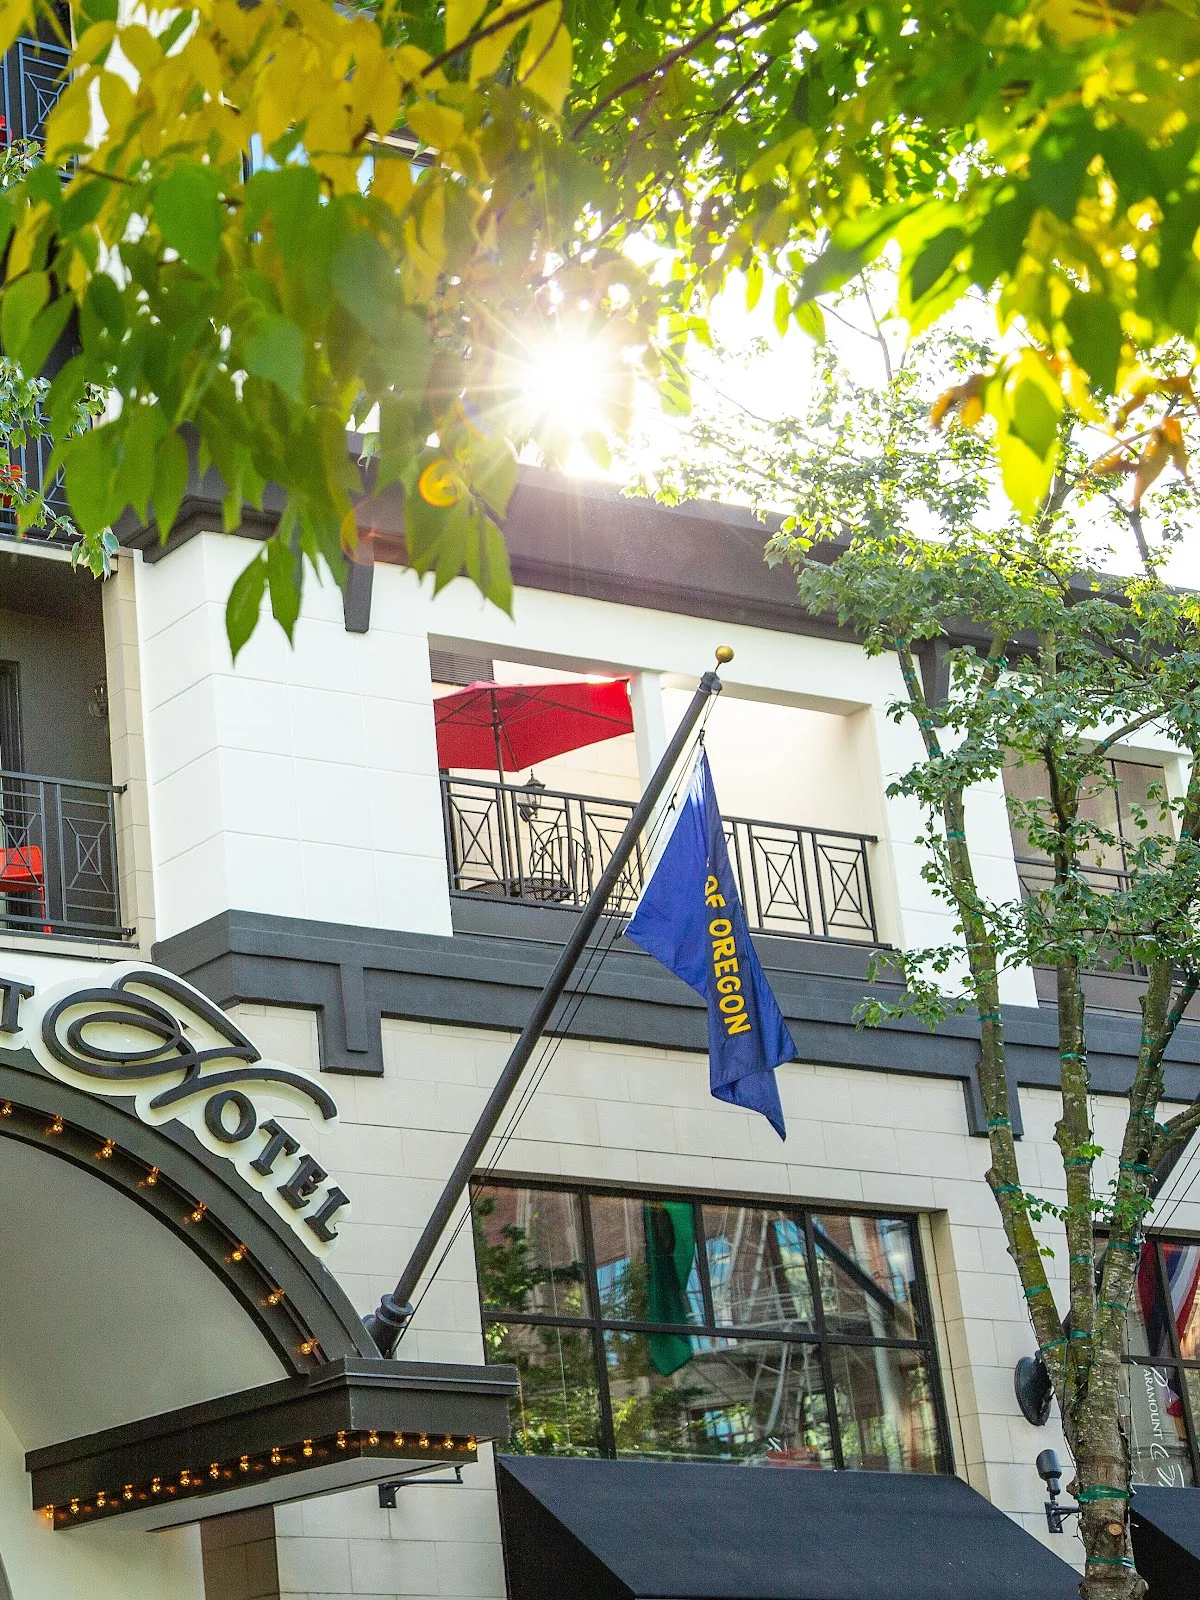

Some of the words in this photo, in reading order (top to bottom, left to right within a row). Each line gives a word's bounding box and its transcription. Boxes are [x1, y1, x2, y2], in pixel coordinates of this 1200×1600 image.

[704, 875, 727, 908] OF
[708, 918, 751, 1036] OREGON
[42, 971, 351, 1243] HOTEL
